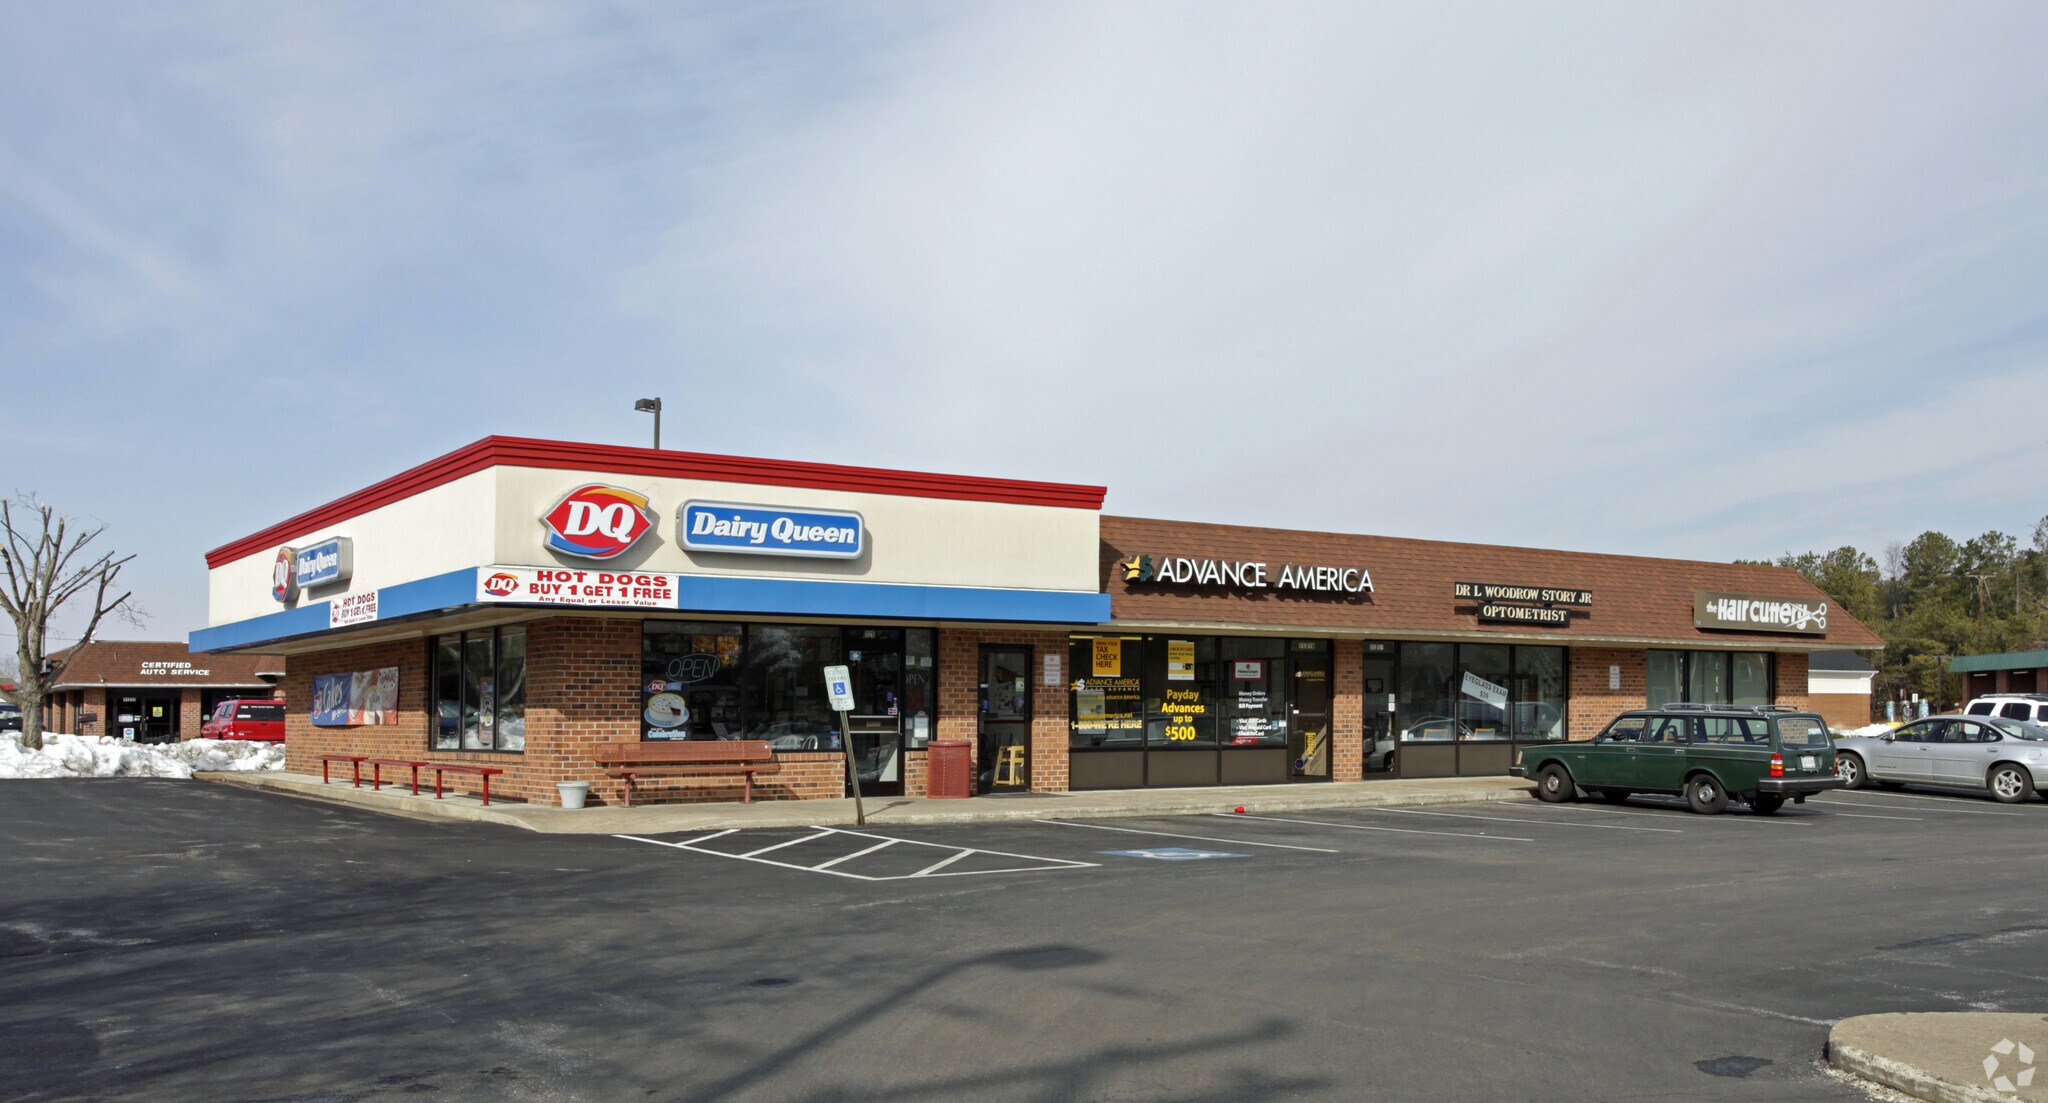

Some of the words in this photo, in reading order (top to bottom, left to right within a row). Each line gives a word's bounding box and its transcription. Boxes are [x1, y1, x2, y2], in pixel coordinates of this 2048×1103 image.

[563, 500, 636, 544] DQ
[692, 511, 768, 544] Dairy
[771, 517, 856, 544] Queen
[298, 555, 316, 577] Dairy
[316, 552, 338, 573] Queen
[274, 558, 289, 589] DQ
[537, 571, 587, 583] HOT
[599, 573, 668, 587] DOGS
[1156, 557, 1267, 588] ADVANCE
[1278, 564, 1375, 593] AMERICA
[489, 577, 515, 593] DQ
[529, 583, 562, 595] BUY
[568, 584, 577, 595] 1
[583, 585, 613, 597] GET
[619, 586, 628, 598] 1
[633, 587, 672, 600] FREE
[342, 596, 356, 608] HOT
[357, 592, 376, 605] DOGS
[560, 596, 584, 604] Equal
[1455, 584, 1471, 596] DR
[1474, 586, 1482, 597] L
[1485, 586, 1539, 600] WOODROW
[1542, 589, 1577, 603] STORY
[1579, 592, 1592, 604] JR
[1483, 604, 1567, 622] OPTOMETRIST
[1706, 601, 1718, 613] the
[1718, 598, 1750, 621] Hair
[142, 661, 191, 669] CERTIFIED
[667, 658, 717, 678] OPEN
[651, 683, 664, 691] DQ
[1465, 673, 1492, 692] EYEGLASS
[1492, 685, 1507, 698] EXAM
[323, 678, 343, 713] Cakes
[1166, 689, 1200, 702] Payday
[1161, 702, 1205, 713] Advances
[1121, 720, 1142, 729] HERE
[1173, 716, 1183, 724] up
[1165, 725, 1196, 741] $500
